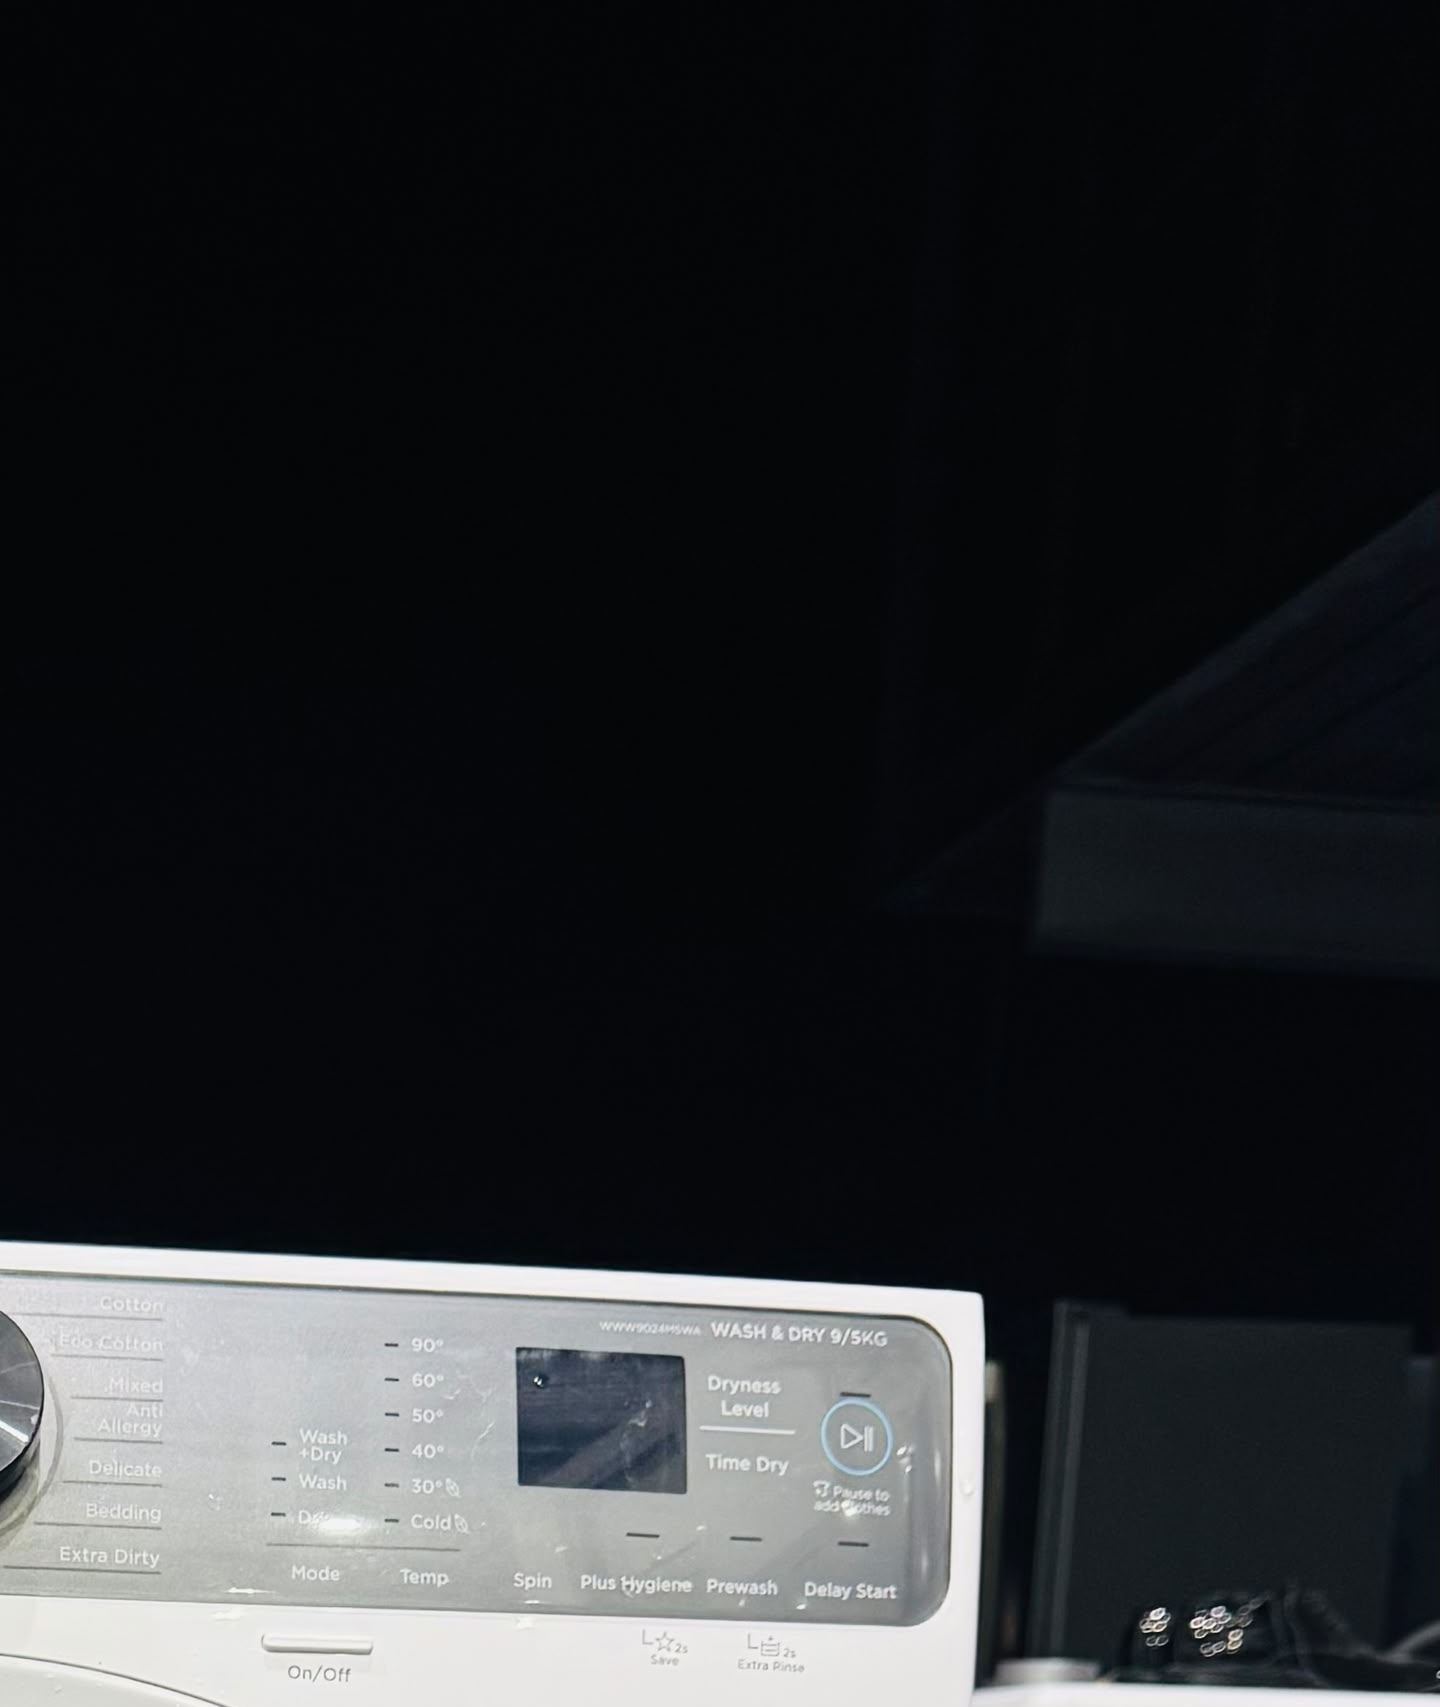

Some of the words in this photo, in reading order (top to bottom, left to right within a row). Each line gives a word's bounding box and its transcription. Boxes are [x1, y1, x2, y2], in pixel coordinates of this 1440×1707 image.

[100, 1296, 164, 1313] Cotton
[60, 1333, 93, 1349] Eco
[98, 1336, 163, 1352] Cotton
[711, 1322, 766, 1340] WASH
[771, 1325, 783, 1341] &
[788, 1327, 826, 1344] DRY
[830, 1328, 888, 1347] 9/5KG
[110, 1378, 164, 1393] Mixed
[707, 1375, 782, 1395] Dryness
[126, 1401, 164, 1418] Anti
[720, 1400, 769, 1418] Level
[98, 1418, 163, 1438] Allergy
[298, 1428, 348, 1446] Wash
[298, 1446, 342, 1465] +Dry
[705, 1453, 751, 1472] Time
[756, 1455, 789, 1475] Dry
[88, 1460, 162, 1477] Delicate
[298, 1473, 347, 1490] Wash
[832, 1485, 873, 1500] Pause
[875, 1487, 891, 1502] to
[86, 1502, 162, 1523] Bedding
[410, 1513, 452, 1531] Cold
[60, 1546, 108, 1563] Extra
[114, 1548, 160, 1568] Dirty
[290, 1565, 341, 1582] Mode
[399, 1568, 449, 1588] Temp
[513, 1572, 553, 1590] Spin
[580, 1574, 617, 1591] Plus
[620, 1575, 693, 1594] Hygiene
[706, 1579, 778, 1596] Prewash
[804, 1581, 852, 1600] Delay
[855, 1583, 898, 1600] Start
[650, 1654, 680, 1666] Save
[737, 1658, 769, 1671] Extra
[772, 1660, 805, 1673] Rinse
[287, 1664, 352, 1683] On/Off
